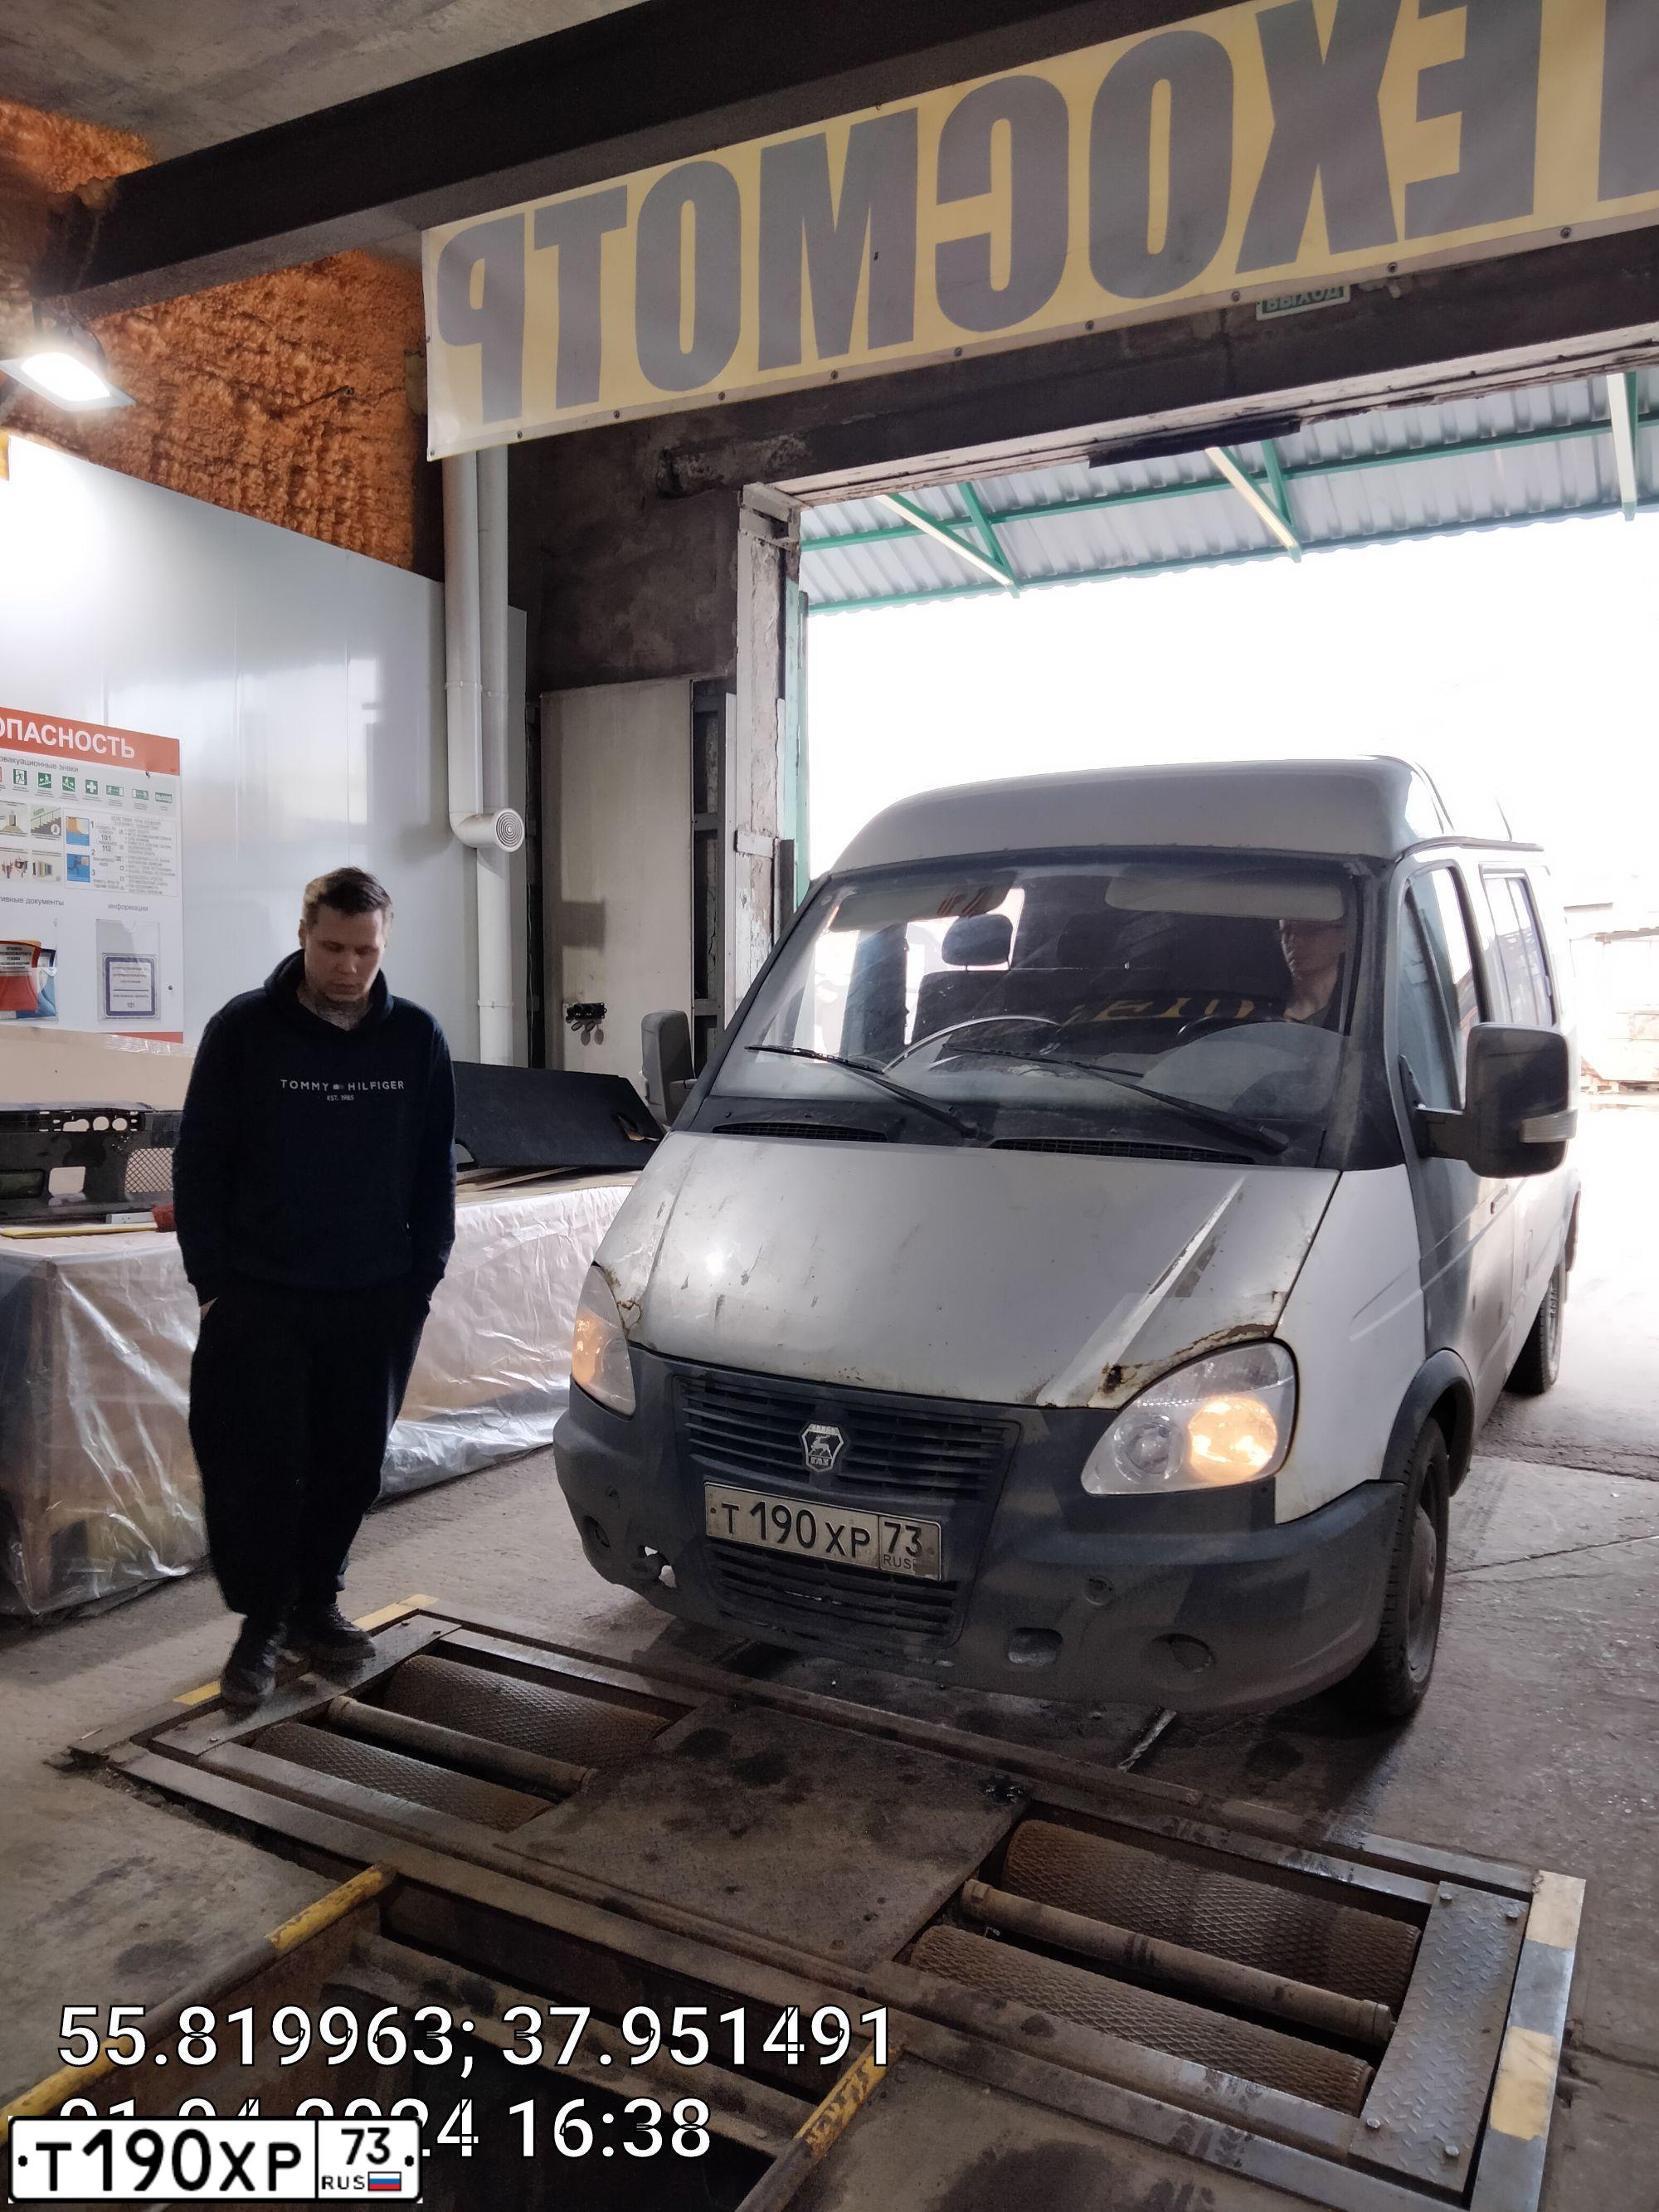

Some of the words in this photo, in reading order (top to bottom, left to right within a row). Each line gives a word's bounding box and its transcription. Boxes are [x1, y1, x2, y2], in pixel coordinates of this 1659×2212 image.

[59, 763, 79, 772] знаки
[25, 898, 65, 907] документы
[280, 1079, 329, 1091] TOMMY
[348, 1080, 405, 1091] HILFIGER
[810, 1456, 829, 1466] ГАЗ
[883, 1521, 923, 1557] 73
[883, 1554, 912, 1570] RUS
